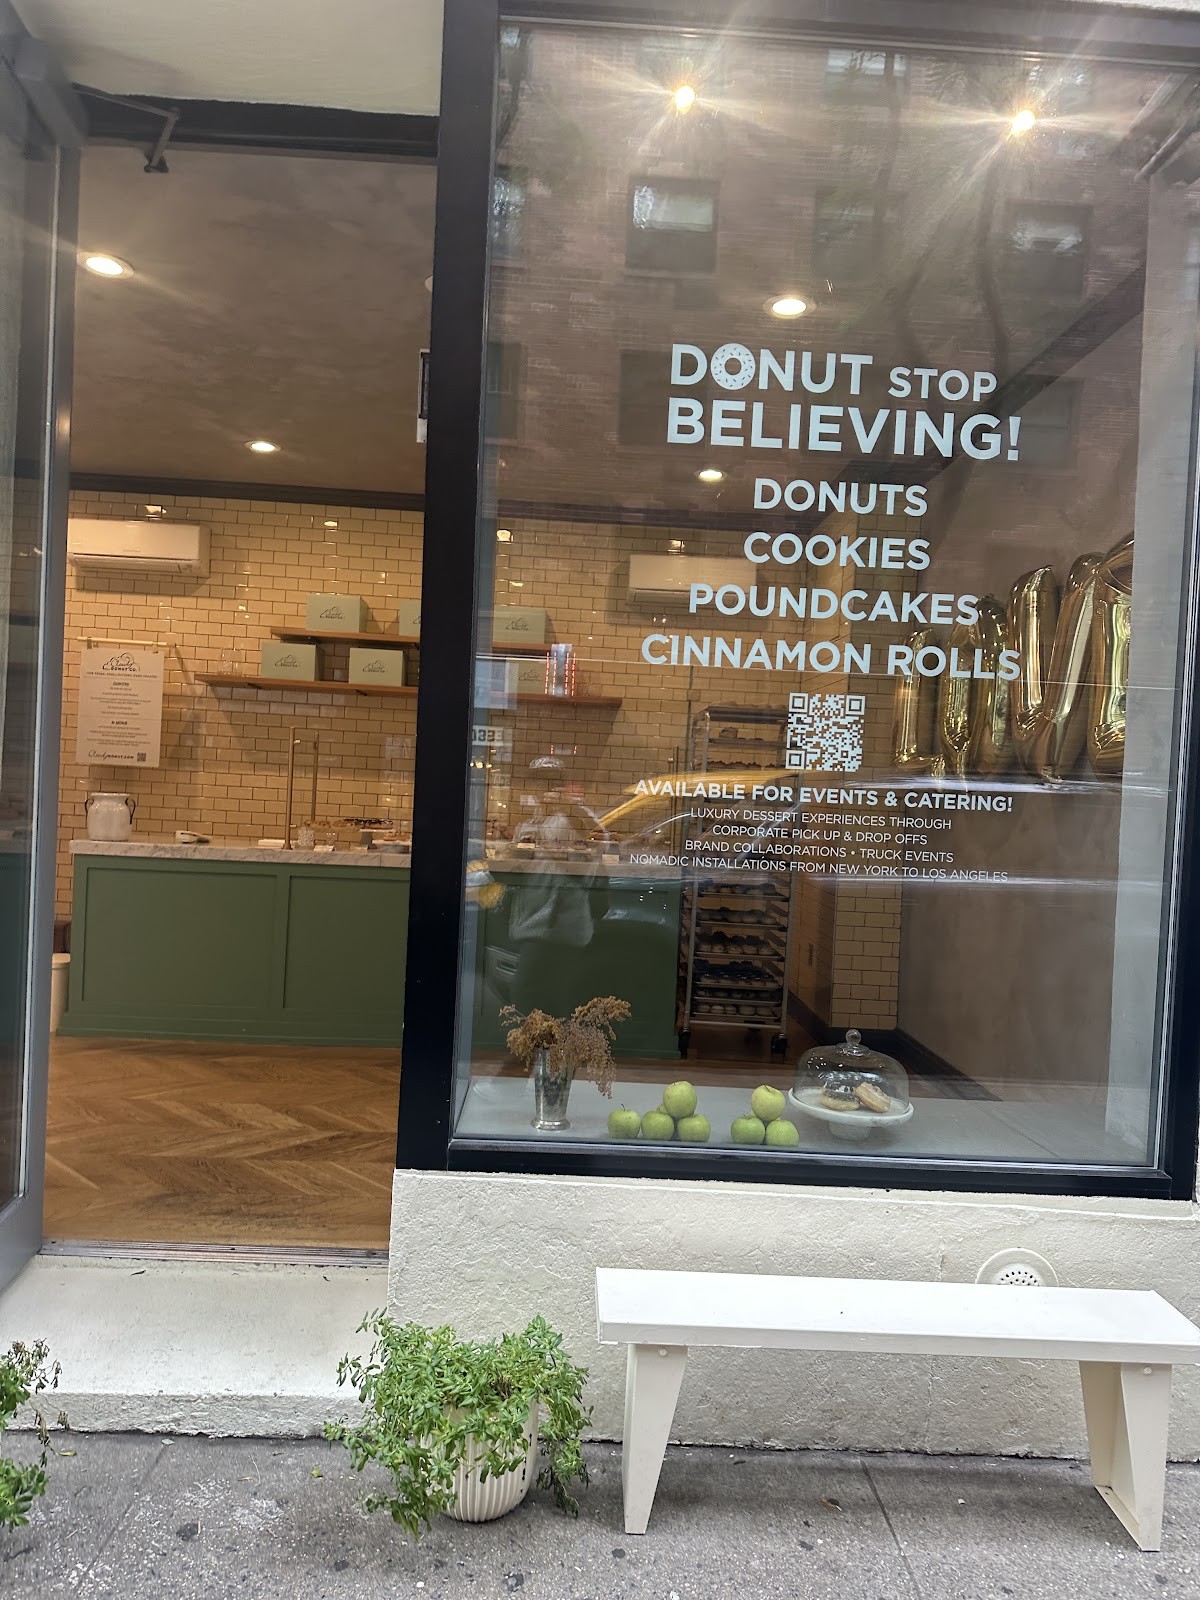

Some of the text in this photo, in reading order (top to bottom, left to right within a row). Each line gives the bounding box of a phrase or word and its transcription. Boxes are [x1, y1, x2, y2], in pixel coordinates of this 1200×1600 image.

[670, 343, 998, 401] DONUT STOP
[667, 397, 1022, 461] BELIEVING!
[754, 477, 928, 517] DONUTS
[744, 531, 931, 570] COOKIES
[688, 583, 979, 625] POUNDCAKES
[641, 634, 1021, 680] CINNAMON ROLLS
[634, 780, 1013, 812] AVAILABLE FOR EVENTS & CATERING!
[690, 808, 952, 829] LUXURY DESSERT EXPERIENCES THROUGH
[712, 825, 927, 845] CORPORATE PICK UP & DROP OFFS
[630, 854, 1008, 882] NOMADIC INSTALLATIONS FROM NEW YORK TO LOS ANGELES
[685, 840, 954, 863] BRAND COLLABORATIONS TRUCK EVENTS
